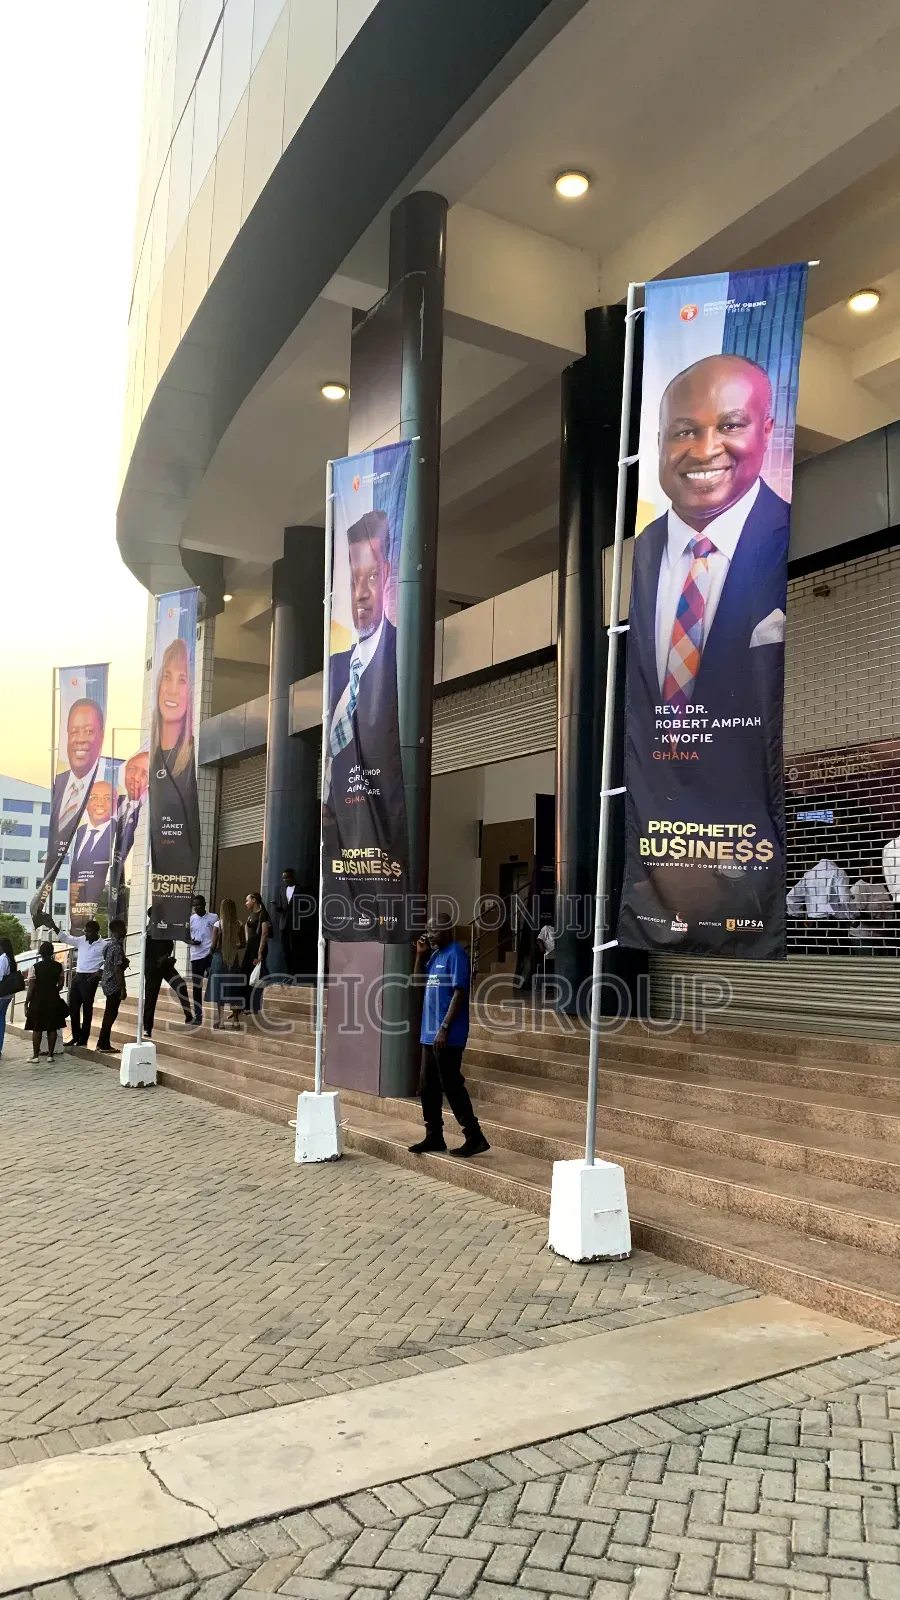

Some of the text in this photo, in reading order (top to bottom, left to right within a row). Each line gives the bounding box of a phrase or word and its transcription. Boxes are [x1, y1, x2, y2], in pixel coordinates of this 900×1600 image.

[655, 704, 709, 715] REV. DR.
[655, 717, 761, 729] ROBERT AMPIAH
[661, 733, 713, 743] KWOFIE
[652, 751, 699, 760] GHANA
[648, 820, 757, 837] PROPHETIC
[639, 836, 774, 863] BU$INE$$
[697, 863, 748, 871] CONFERENCE
[736, 919, 764, 928] UPSA
